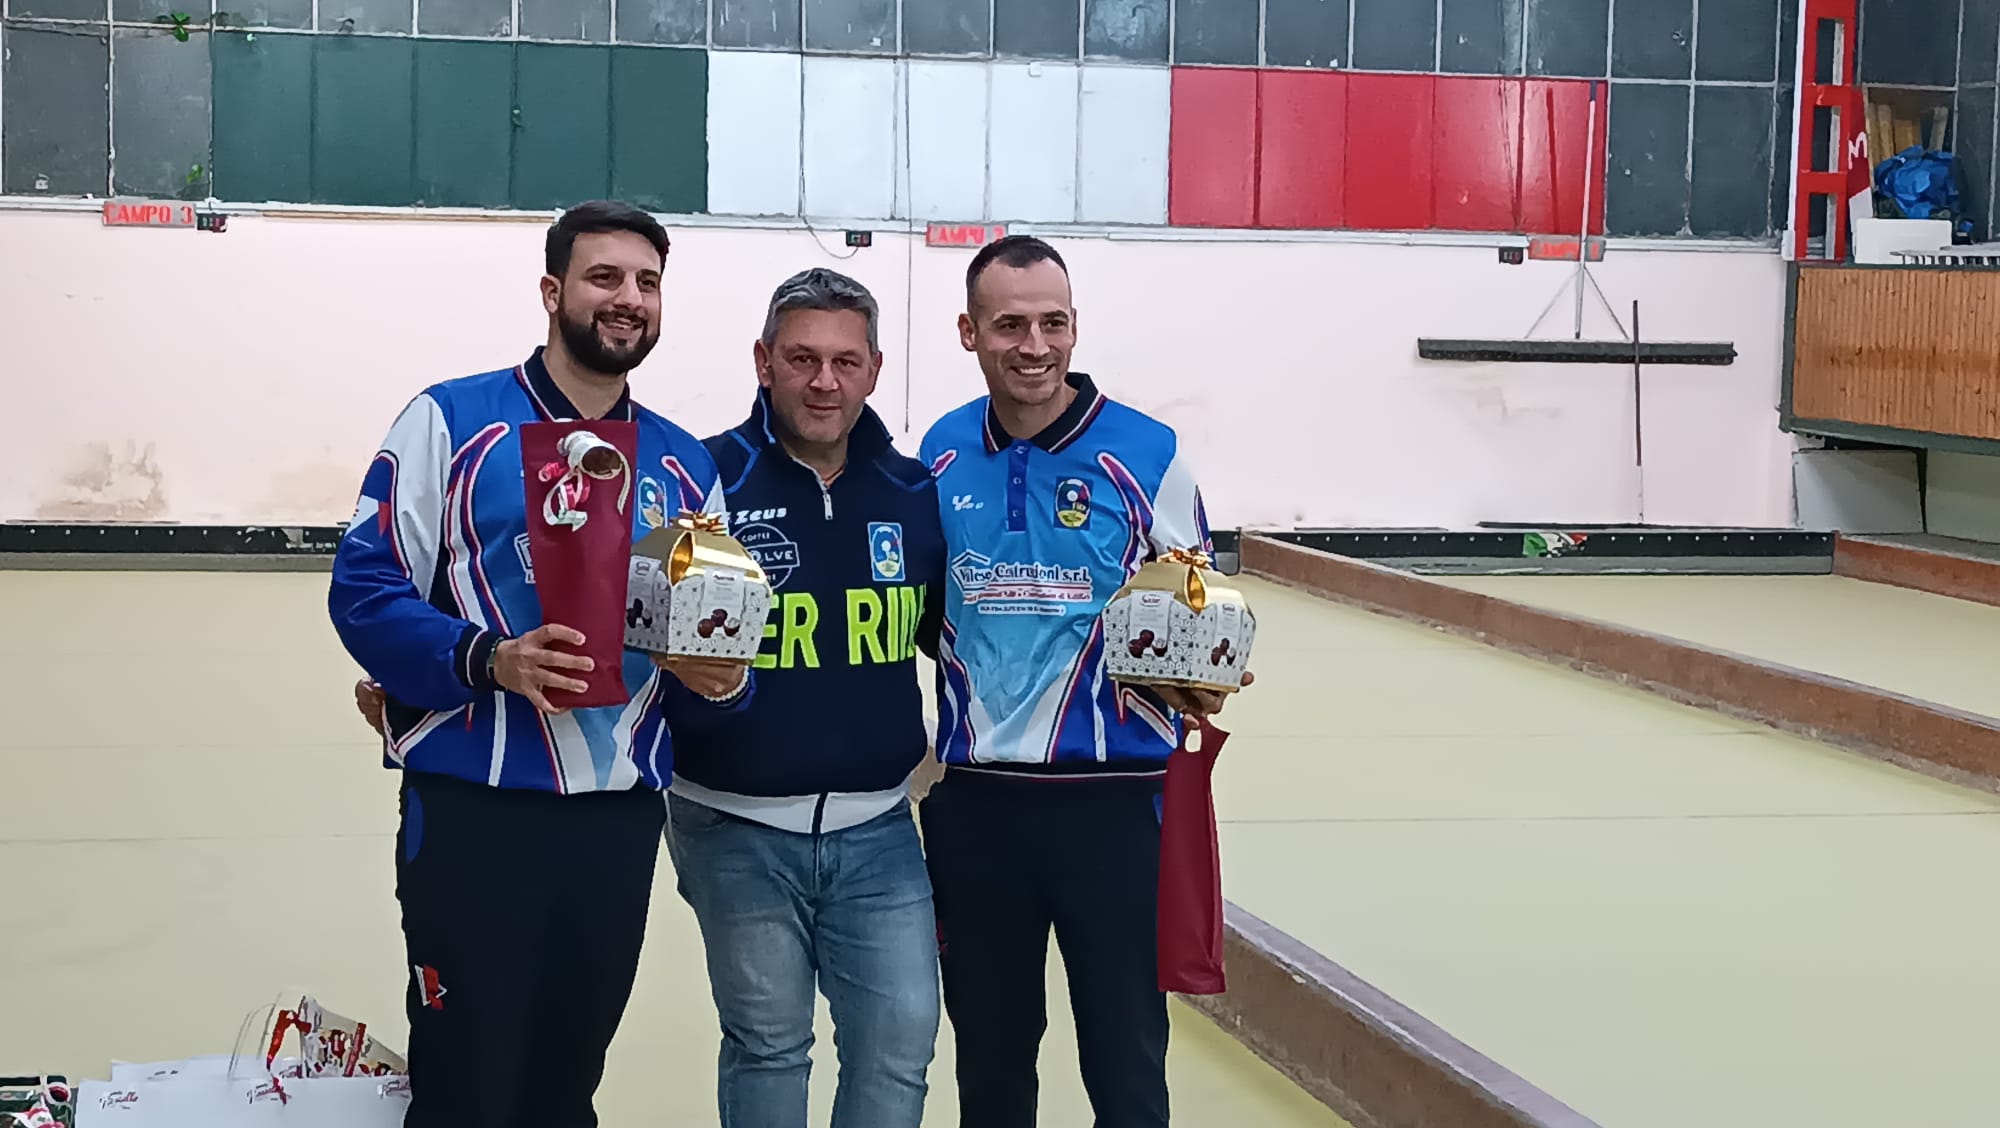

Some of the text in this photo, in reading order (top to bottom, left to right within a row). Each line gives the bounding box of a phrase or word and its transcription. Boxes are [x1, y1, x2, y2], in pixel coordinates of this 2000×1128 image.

[104, 203, 171, 224] CAMPO
[180, 206, 193, 224] 3
[734, 507, 787, 525] Zeus
